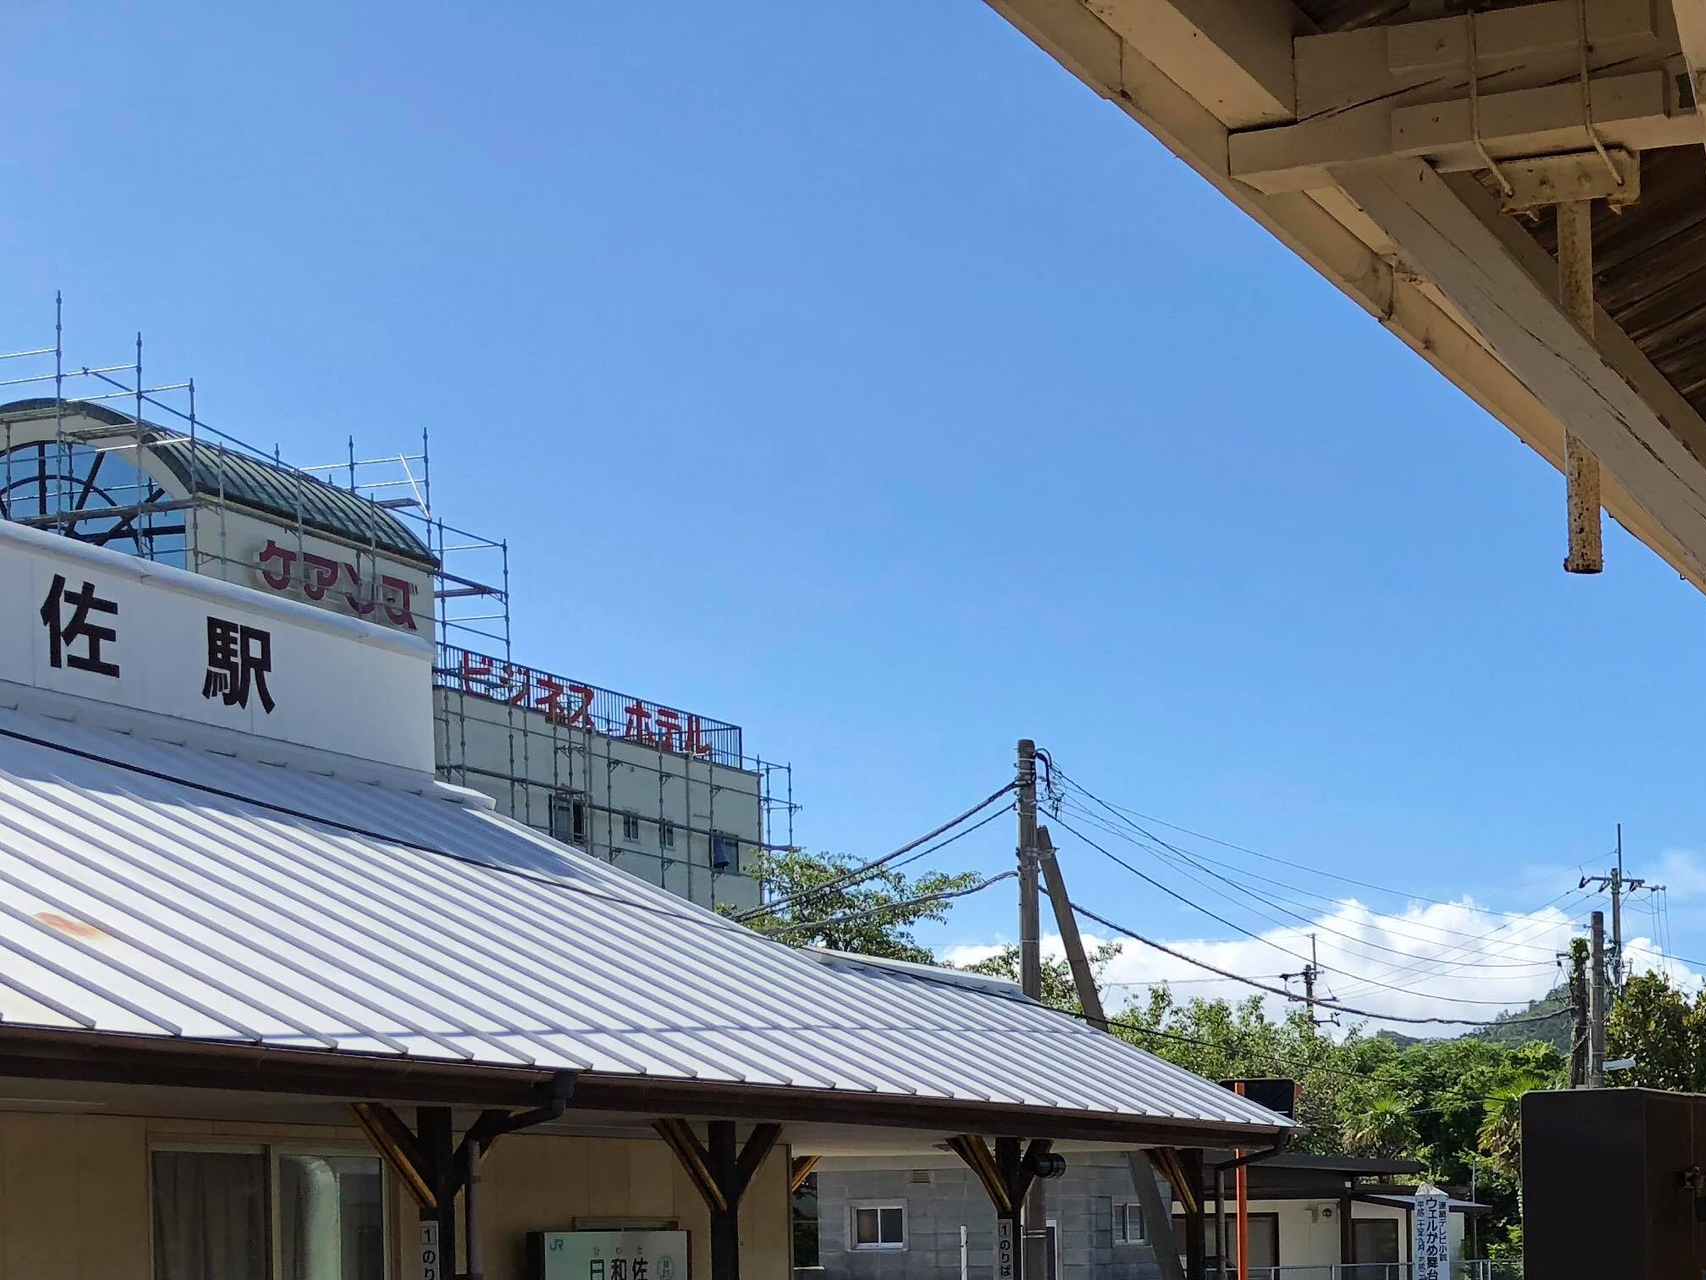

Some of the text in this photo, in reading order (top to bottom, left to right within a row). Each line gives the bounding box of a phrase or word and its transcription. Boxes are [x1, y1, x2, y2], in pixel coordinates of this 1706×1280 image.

[258, 539, 418, 631] ケアンズ
[463, 650, 711, 754] ビジネス ホテル
[550, 1239, 564, 1251] JR
